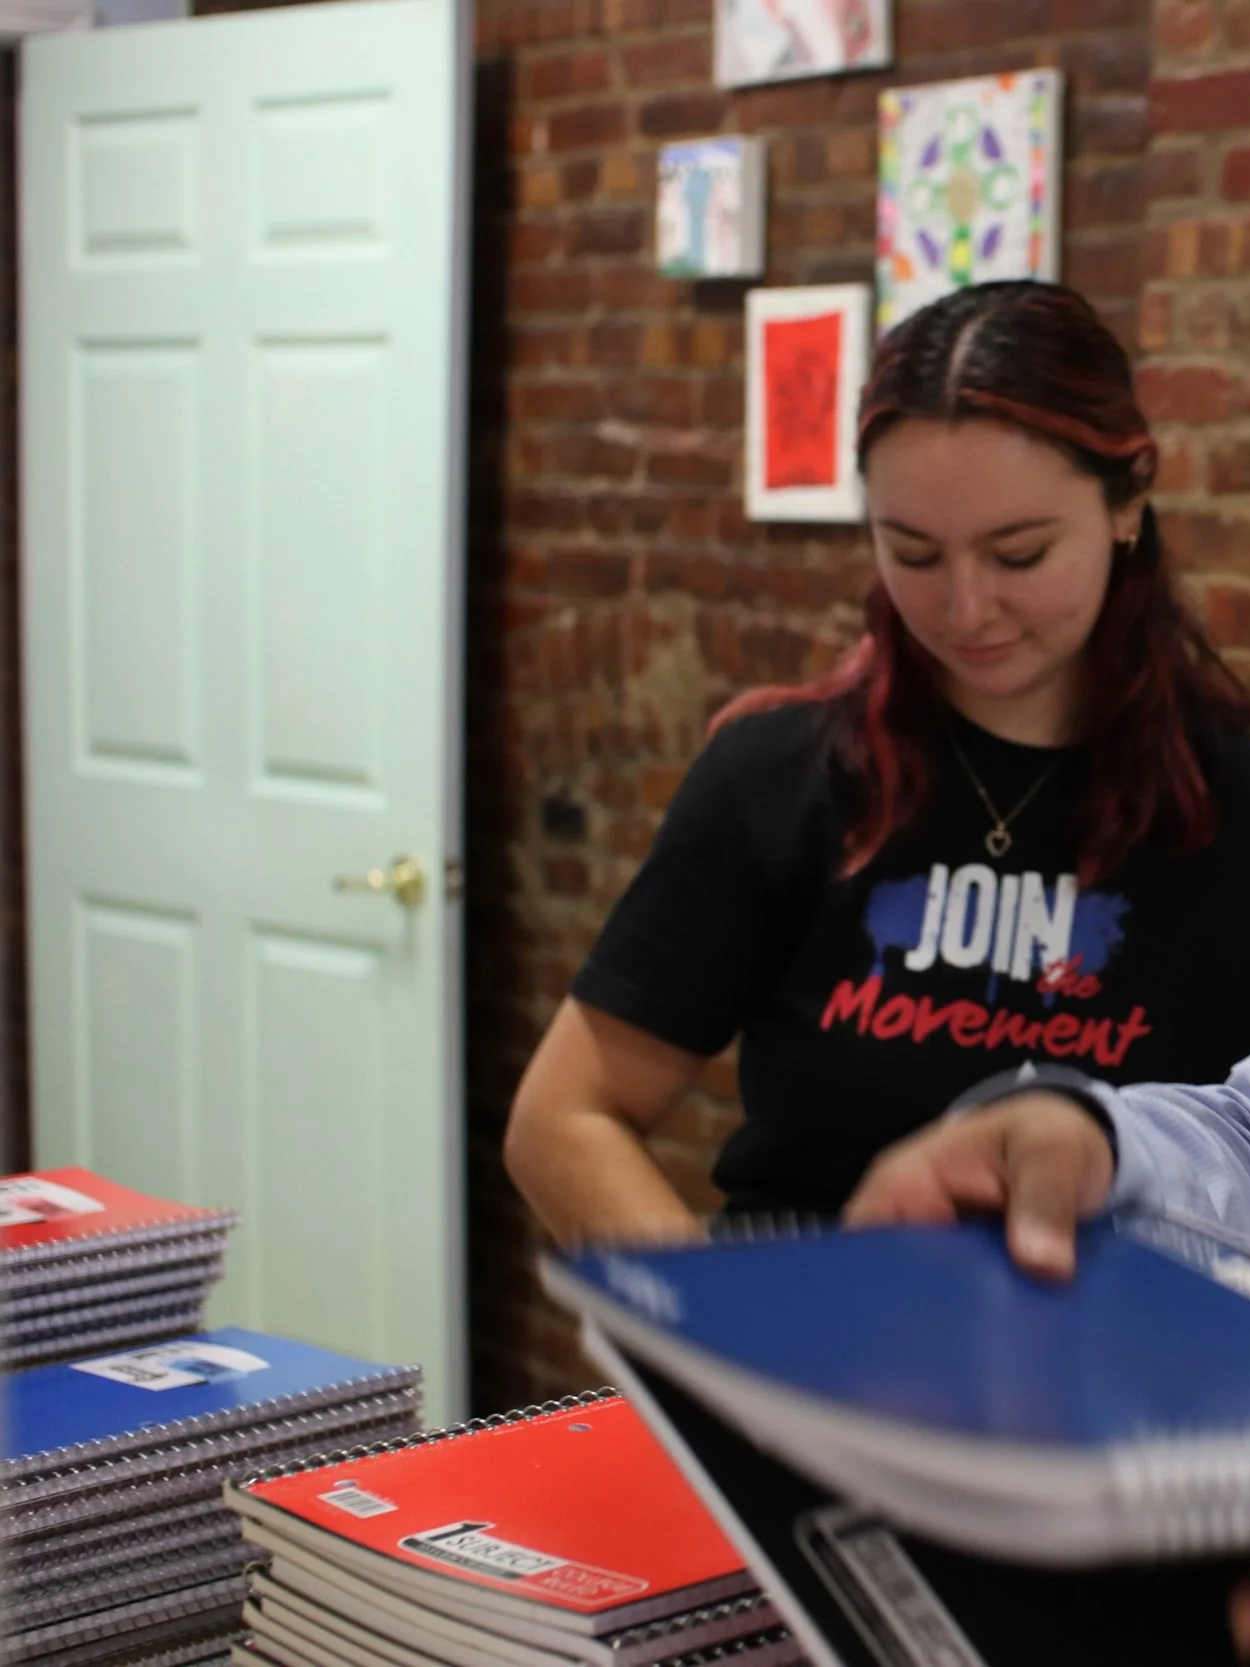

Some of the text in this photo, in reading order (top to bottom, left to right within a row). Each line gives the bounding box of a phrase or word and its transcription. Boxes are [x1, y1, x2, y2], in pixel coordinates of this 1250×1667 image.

[904, 863, 1077, 982] JOIN
[1035, 952, 1101, 998] the
[819, 975, 1151, 1066] Movement
[426, 1522, 489, 1541] 1
[445, 1534, 557, 1571] SUBJECT
